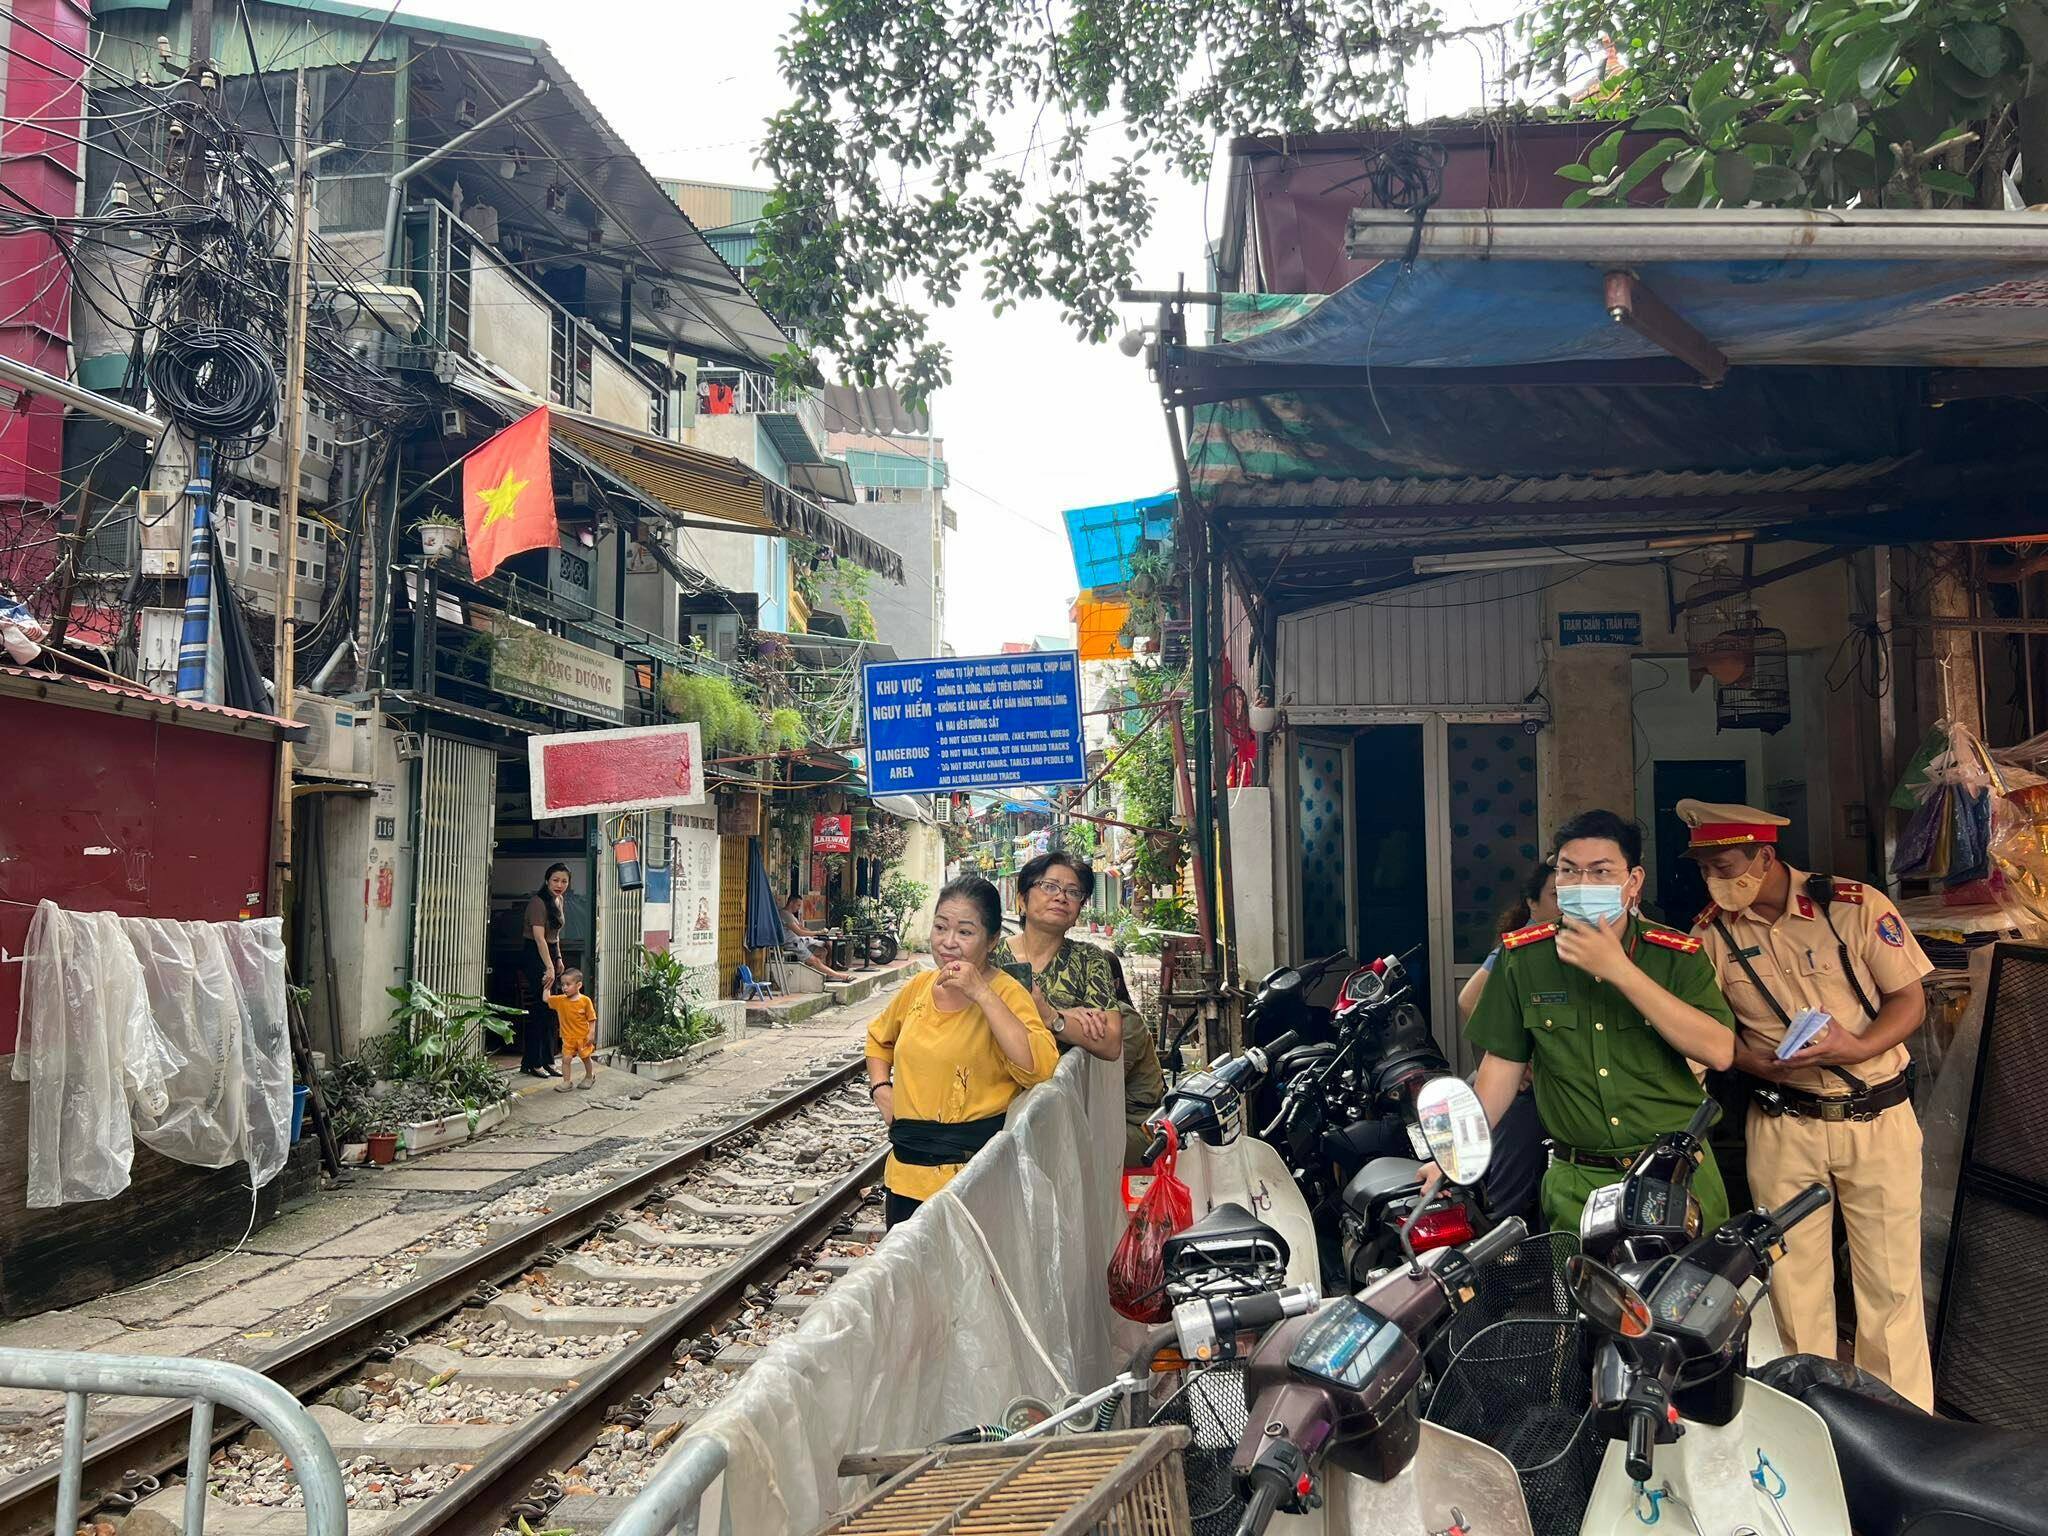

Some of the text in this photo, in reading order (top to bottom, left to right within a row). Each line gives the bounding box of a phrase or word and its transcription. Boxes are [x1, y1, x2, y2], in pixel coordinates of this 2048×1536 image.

[1011, 663, 1026, 676] QUAY
[876, 678, 923, 697] KHU VỰC
[872, 697, 932, 721] NGUY HIỂM
[940, 737, 948, 745] DO
[949, 736, 960, 745] NOT
[961, 734, 982, 744] GATHER
[983, 734, 988, 742] A
[1050, 729, 1070, 738] VIDEOS
[874, 746, 930, 762] DANGEROUS
[941, 750, 949, 758] DO
[950, 749, 961, 758] NOT
[1001, 746, 1010, 754] SIT
[1011, 745, 1020, 753] ON
[1020, 744, 1048, 753] RAILROAD
[1048, 742, 1070, 751] TRACKS
[950, 762, 962, 771] NOT
[962, 761, 986, 770] DISPLAY
[1010, 757, 1030, 767] TABLES
[1031, 757, 1043, 765] AND
[890, 766, 914, 780] AREA
[939, 772, 1020, 784] AND ALONG RAILROAD TRACKS
[378, 819, 393, 836] 116
[814, 836, 849, 845] RAILWAY
